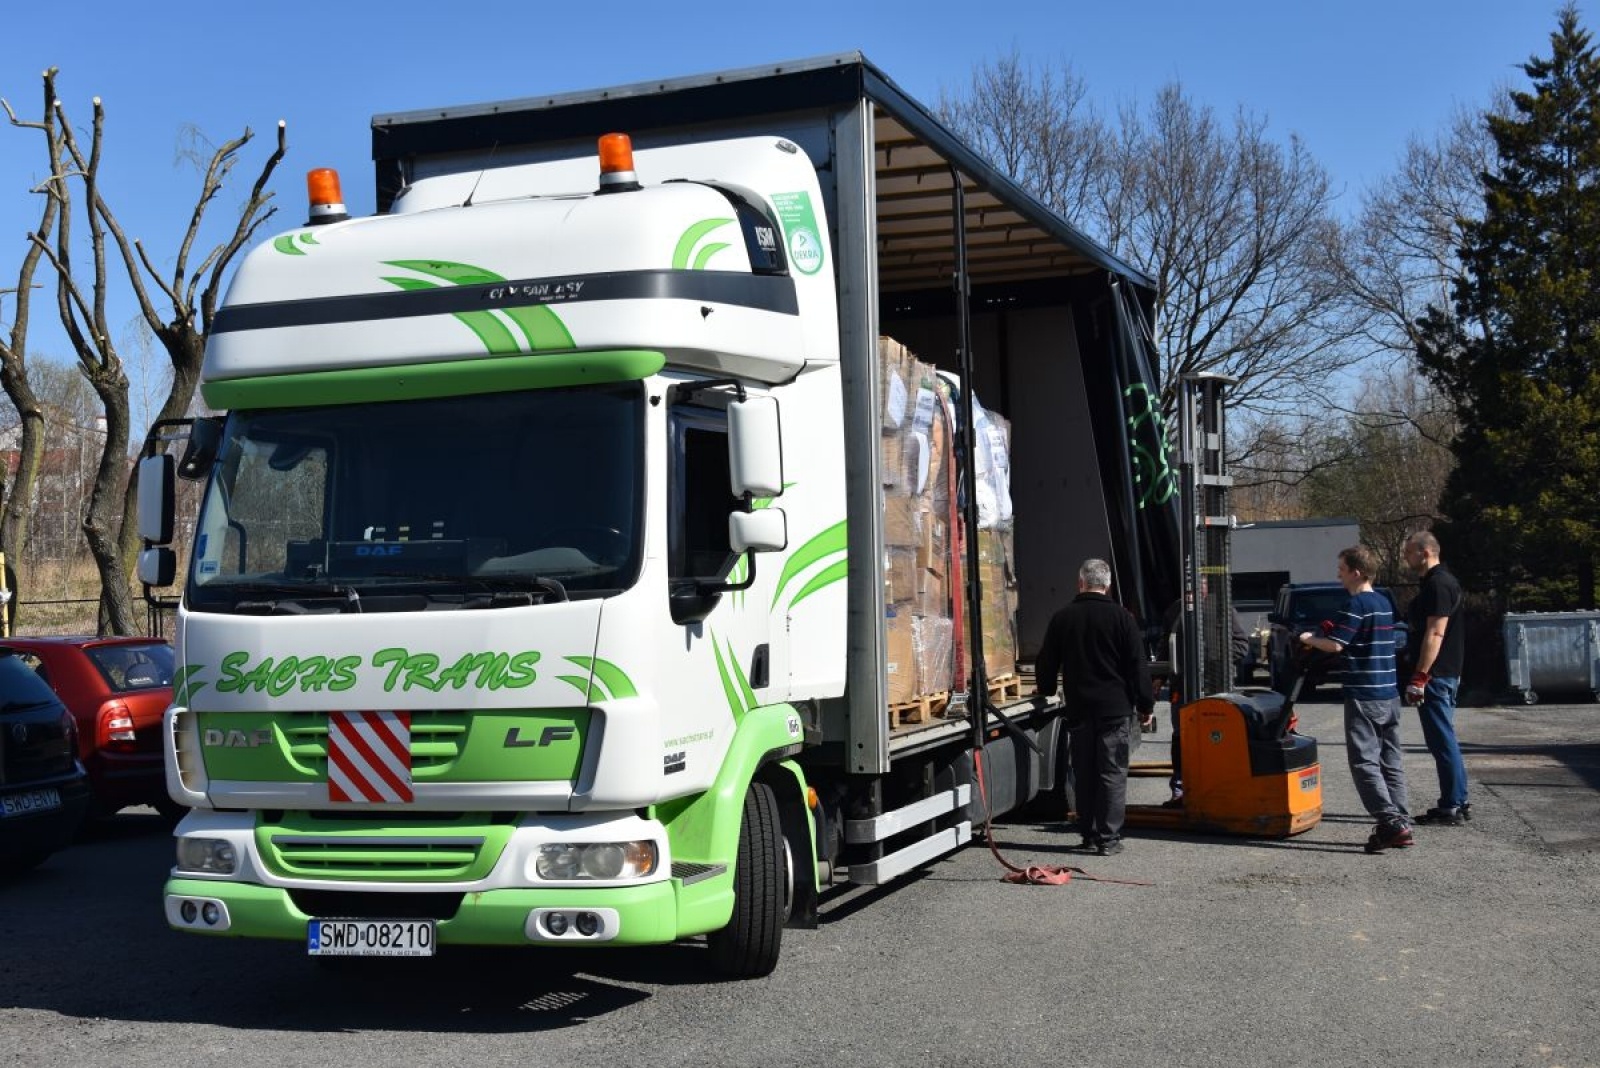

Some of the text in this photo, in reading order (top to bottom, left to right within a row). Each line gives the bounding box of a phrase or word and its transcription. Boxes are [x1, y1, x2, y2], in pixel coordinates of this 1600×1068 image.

[356, 546, 404, 556] DAF
[216, 648, 541, 697] SACHS TRANS
[204, 726, 576, 748] DAF LF
[663, 751, 686, 765] DAF
[320, 923, 430, 948] SWD 08210
